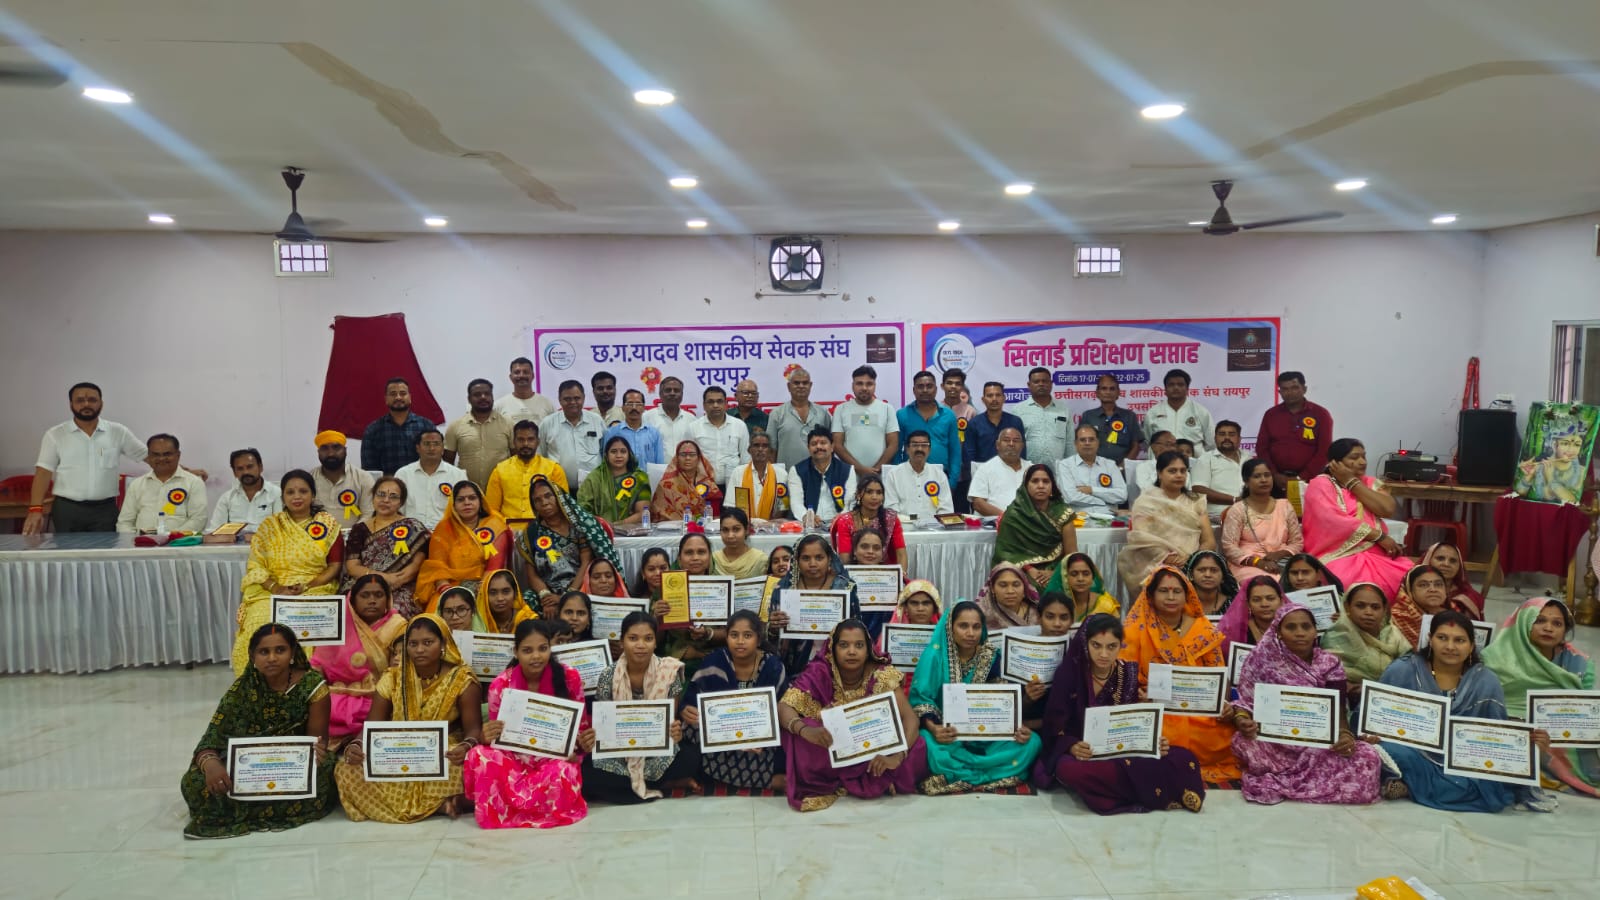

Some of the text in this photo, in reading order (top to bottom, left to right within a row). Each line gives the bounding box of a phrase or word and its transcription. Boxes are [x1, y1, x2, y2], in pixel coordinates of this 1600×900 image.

[684, 335, 763, 361] शासकीय
[766, 335, 816, 359] सेवक
[819, 334, 851, 358] संघ
[1002, 338, 1201, 368] सिलाई प्रशिक्षण सप्ताह
[696, 367, 751, 392] रायपुर
[1079, 374, 1106, 383] 17-07-
[1223, 387, 1250, 399] रायपुर
